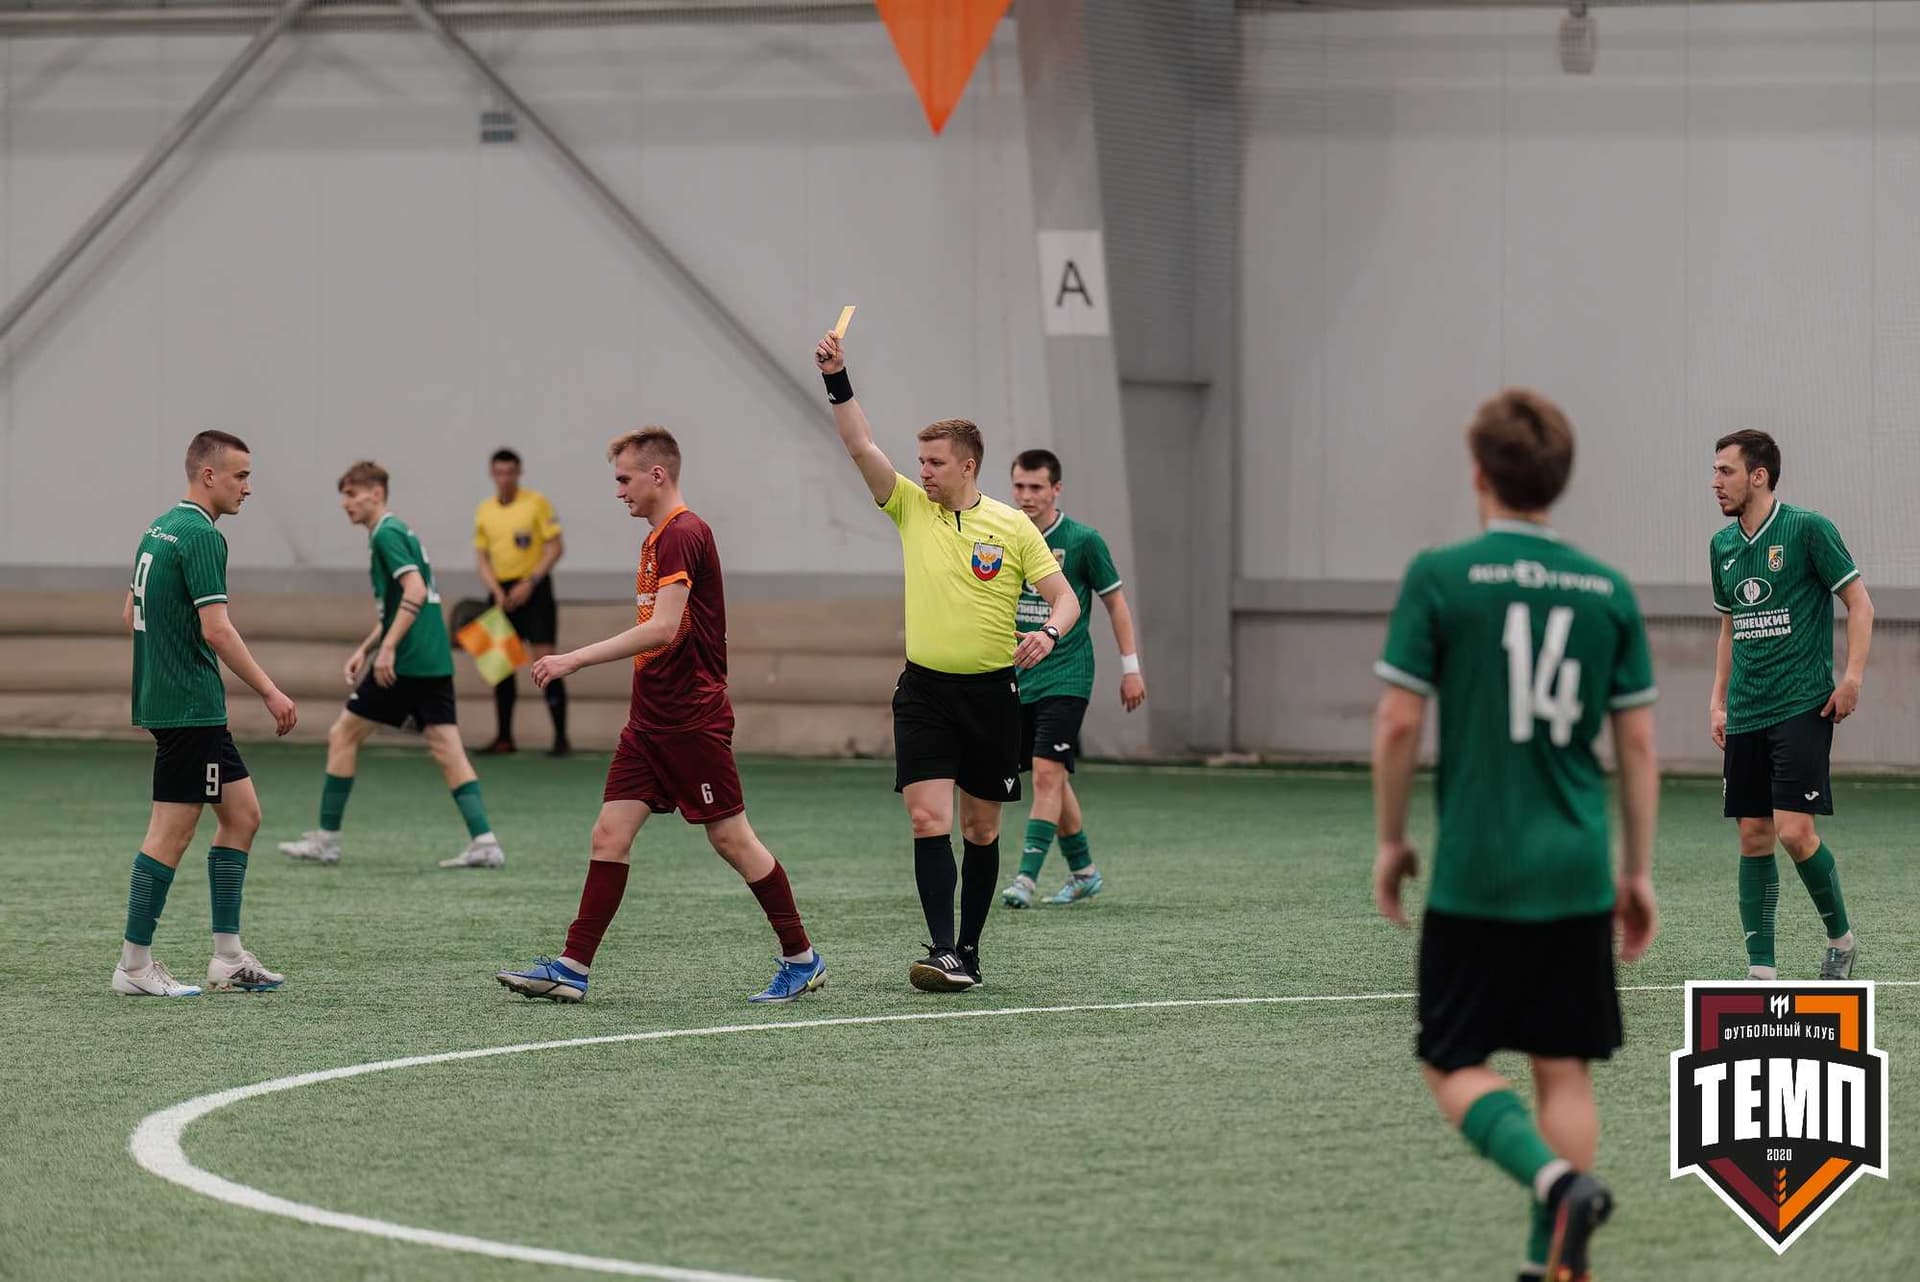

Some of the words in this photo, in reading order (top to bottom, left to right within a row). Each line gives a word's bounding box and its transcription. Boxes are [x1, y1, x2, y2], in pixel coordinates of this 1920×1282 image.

[133, 551, 154, 632] 9
[1502, 601, 1583, 746] 14
[206, 763, 219, 796] 9
[701, 783, 714, 805] 6
